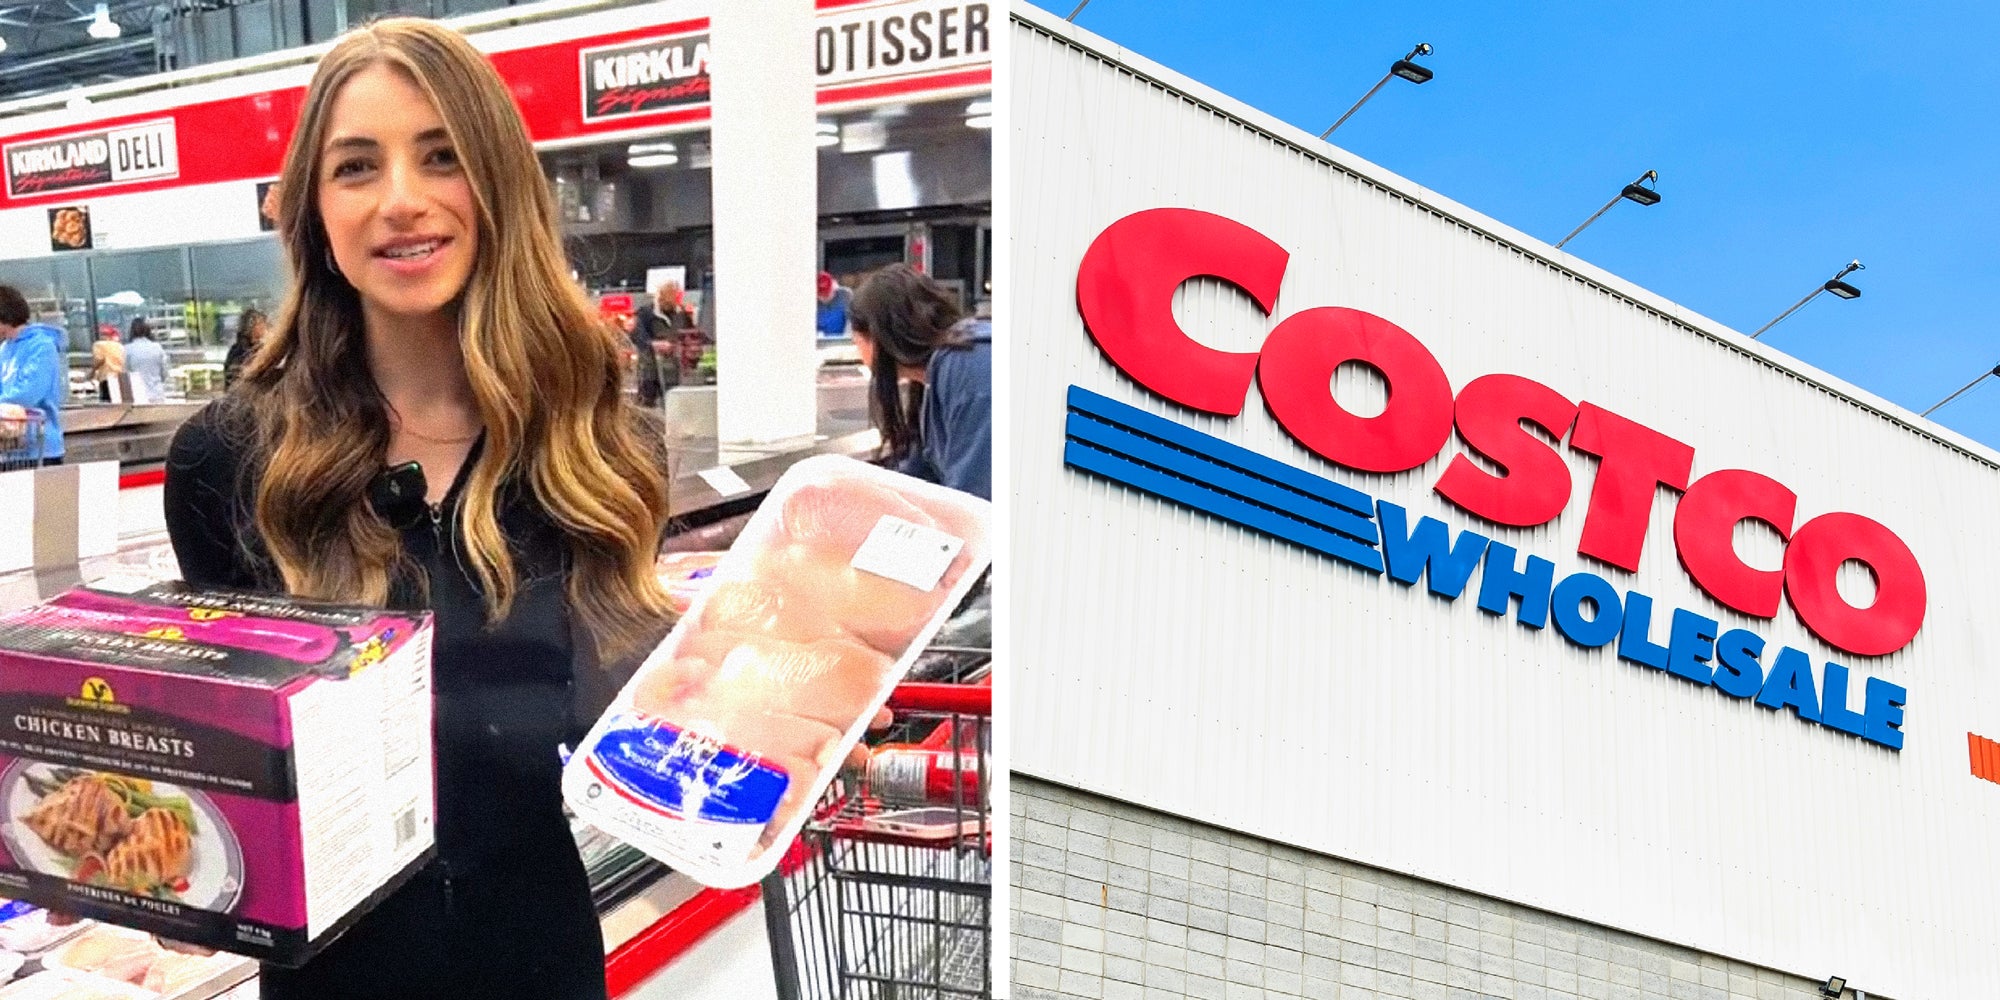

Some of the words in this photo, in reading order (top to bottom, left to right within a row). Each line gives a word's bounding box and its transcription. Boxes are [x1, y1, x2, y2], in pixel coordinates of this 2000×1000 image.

[12, 139, 108, 176] KIRKLAND
[117, 132, 164, 172] DELI
[1076, 207, 1927, 657] COSTCO
[1376, 499, 1907, 751] WHOLESALE
[14, 714, 101, 742] CHICKEN
[107, 728, 195, 759] BREASTS
